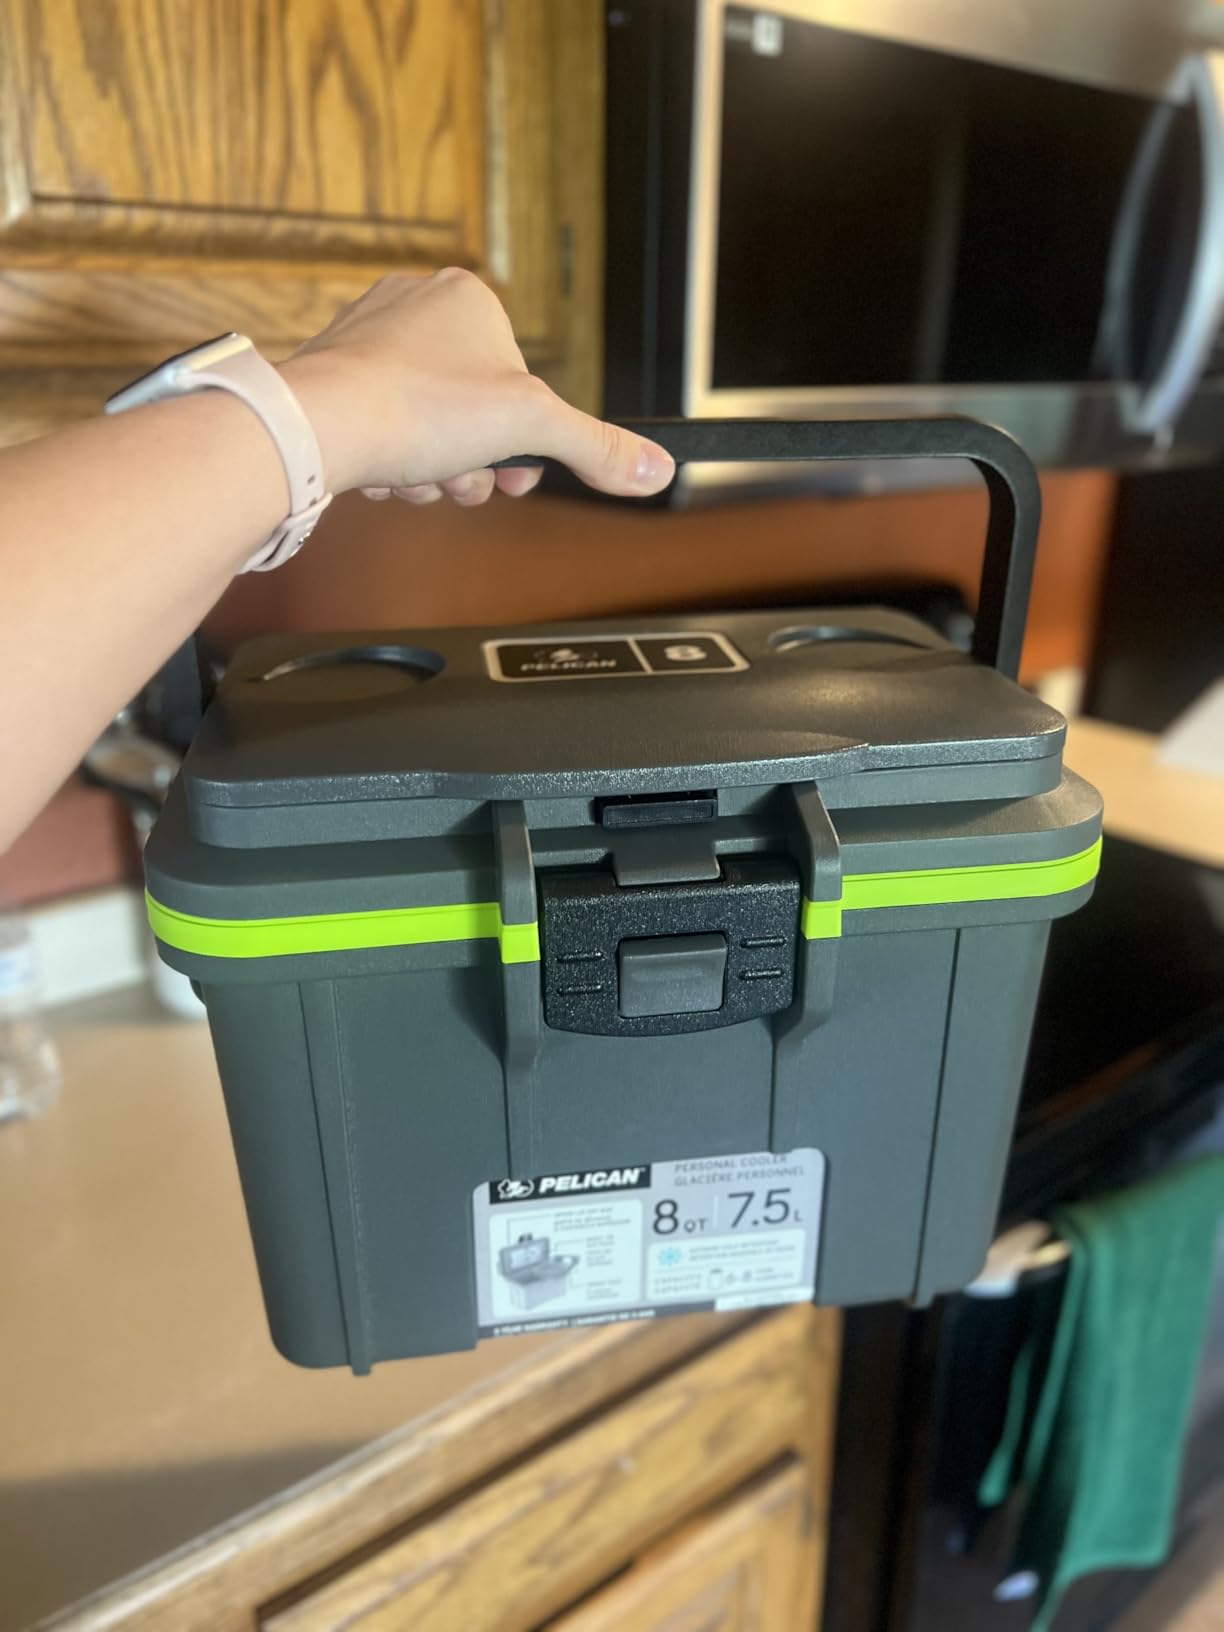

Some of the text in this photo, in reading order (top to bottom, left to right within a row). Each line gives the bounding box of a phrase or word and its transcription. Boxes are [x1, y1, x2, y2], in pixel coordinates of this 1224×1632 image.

[538, 1168, 641, 1193] PELICAN
[674, 1157, 737, 1173] PERSONAL
[652, 1198, 680, 1236] 8
[728, 1188, 791, 1229] 7.5
